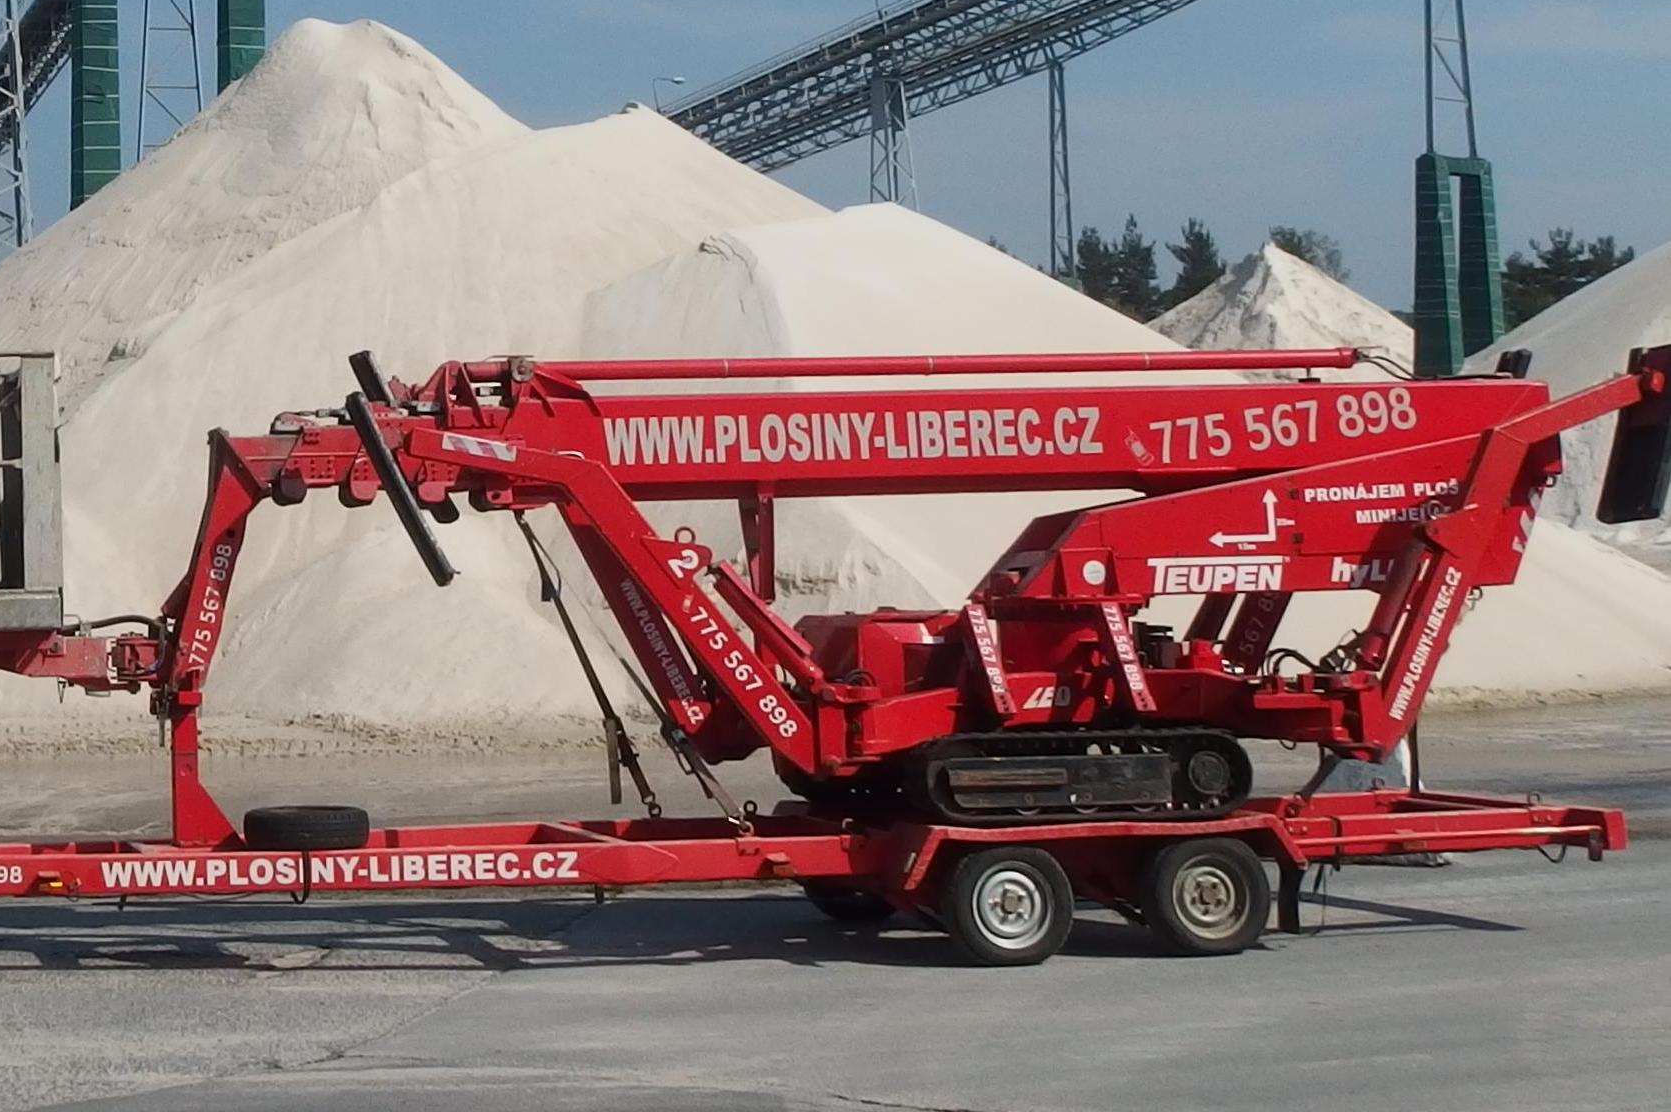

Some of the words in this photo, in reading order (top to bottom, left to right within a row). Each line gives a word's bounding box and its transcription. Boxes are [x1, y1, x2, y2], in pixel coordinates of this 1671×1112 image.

[603, 407, 1103, 466] WWW.PLOSINY-LIBEREC.CZ
[1149, 413, 1231, 464] 775
[1244, 400, 1318, 451] 567
[1336, 387, 1417, 437] 898
[1304, 482, 1406, 503] PRONÁJEM
[210, 544, 233, 582] 898
[668, 549, 699, 579] 2
[1147, 556, 1283, 593] TEUPEN
[200, 586, 221, 624] 567
[188, 629, 212, 666] 775
[968, 608, 987, 634] 775
[978, 637, 997, 664] 567
[1103, 605, 1123, 632] 775
[1113, 635, 1135, 666] 567
[1389, 566, 1463, 720] WWW.PLOSINY-LIBEREC.CZ
[690, 606, 729, 650] 775
[724, 650, 763, 691] 567
[759, 695, 798, 737] 898
[102, 852, 579, 887] WWW.PLOSINY-LIBEREC.CZ
